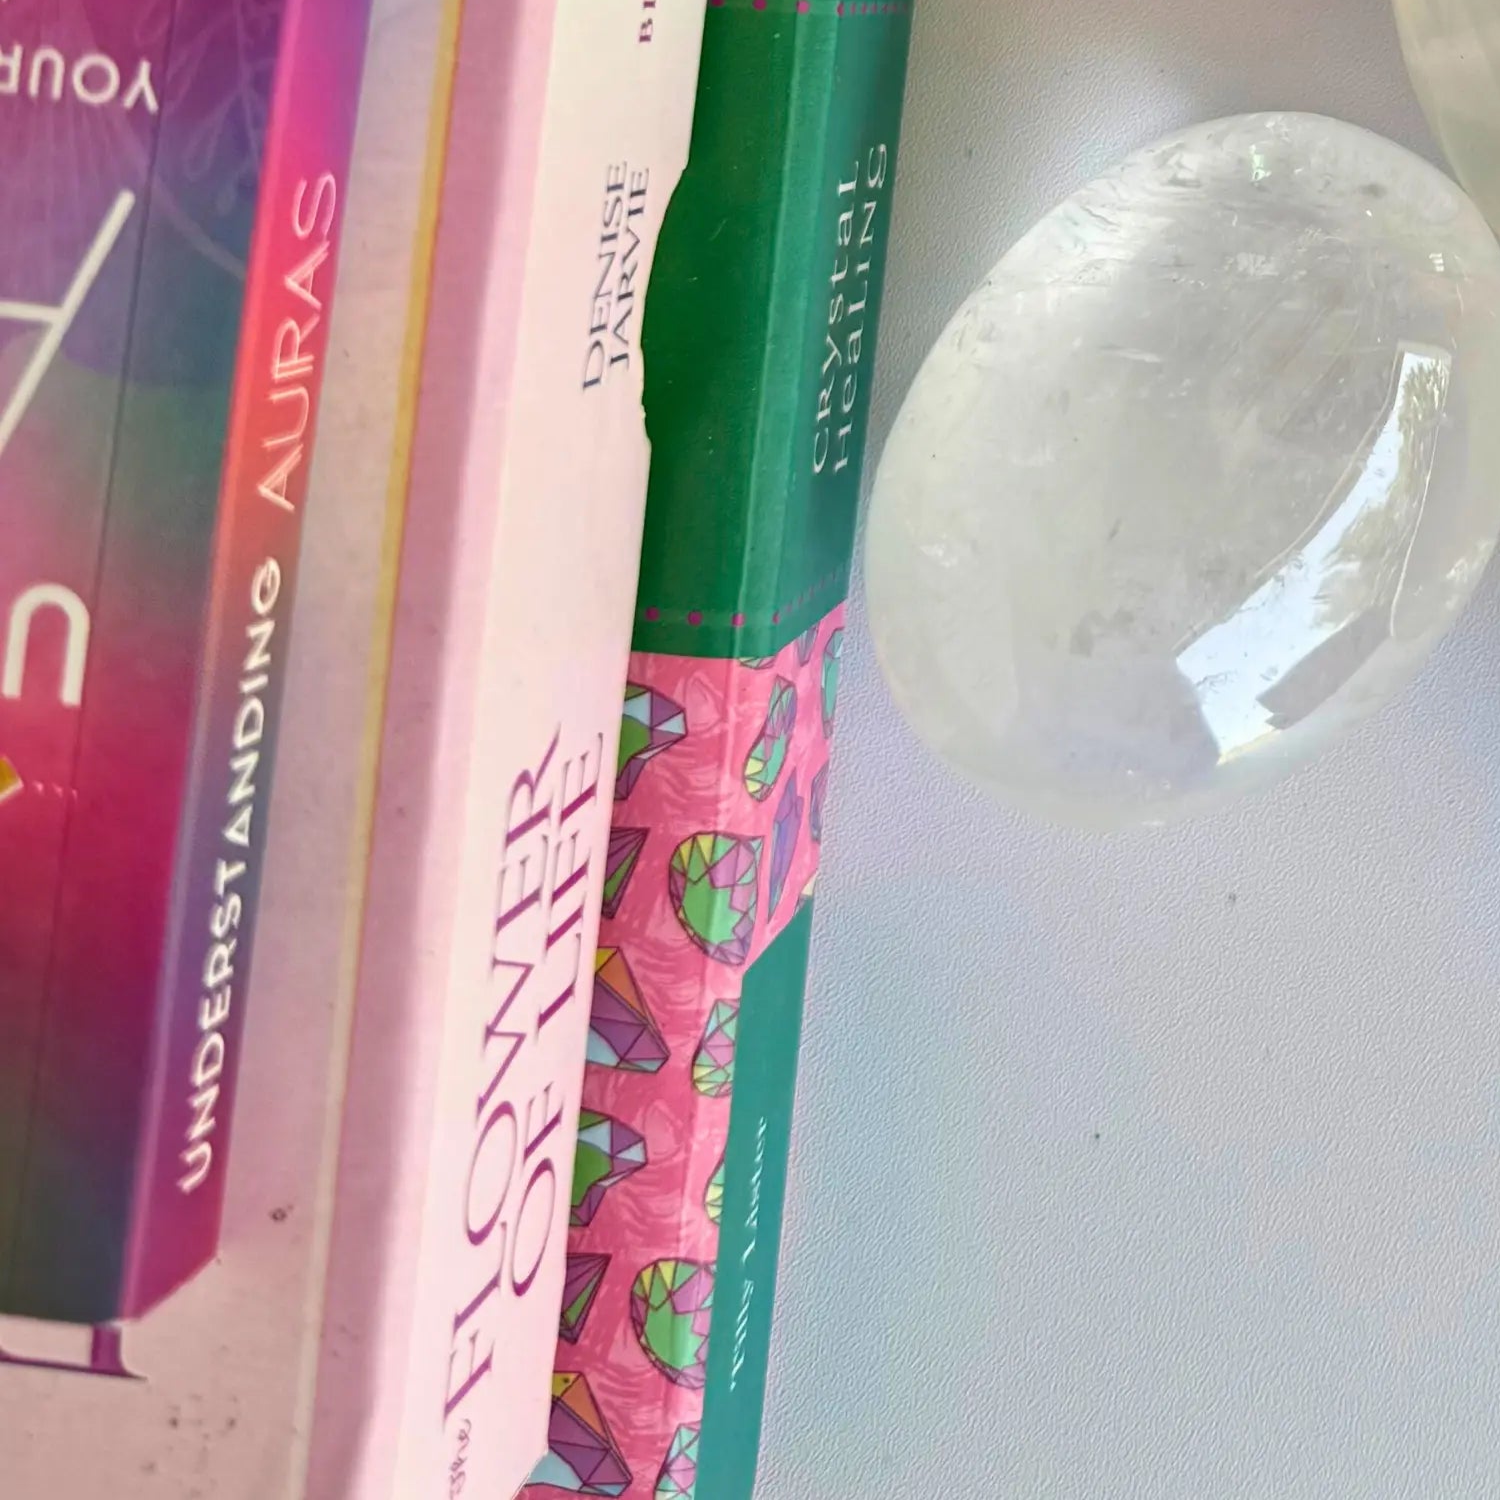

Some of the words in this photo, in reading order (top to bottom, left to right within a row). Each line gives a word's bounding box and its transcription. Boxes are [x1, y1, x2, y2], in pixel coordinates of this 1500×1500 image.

[582, 160, 628, 393] DENISE
[608, 167, 650, 370] JARVIE
[177, 554, 282, 1195] UNDERSTANDING
[256, 170, 338, 511] AURAS
[537, 731, 605, 1037] LIFE
[442, 721, 563, 1419] FLOWER
[509, 1081, 572, 1297] OF
